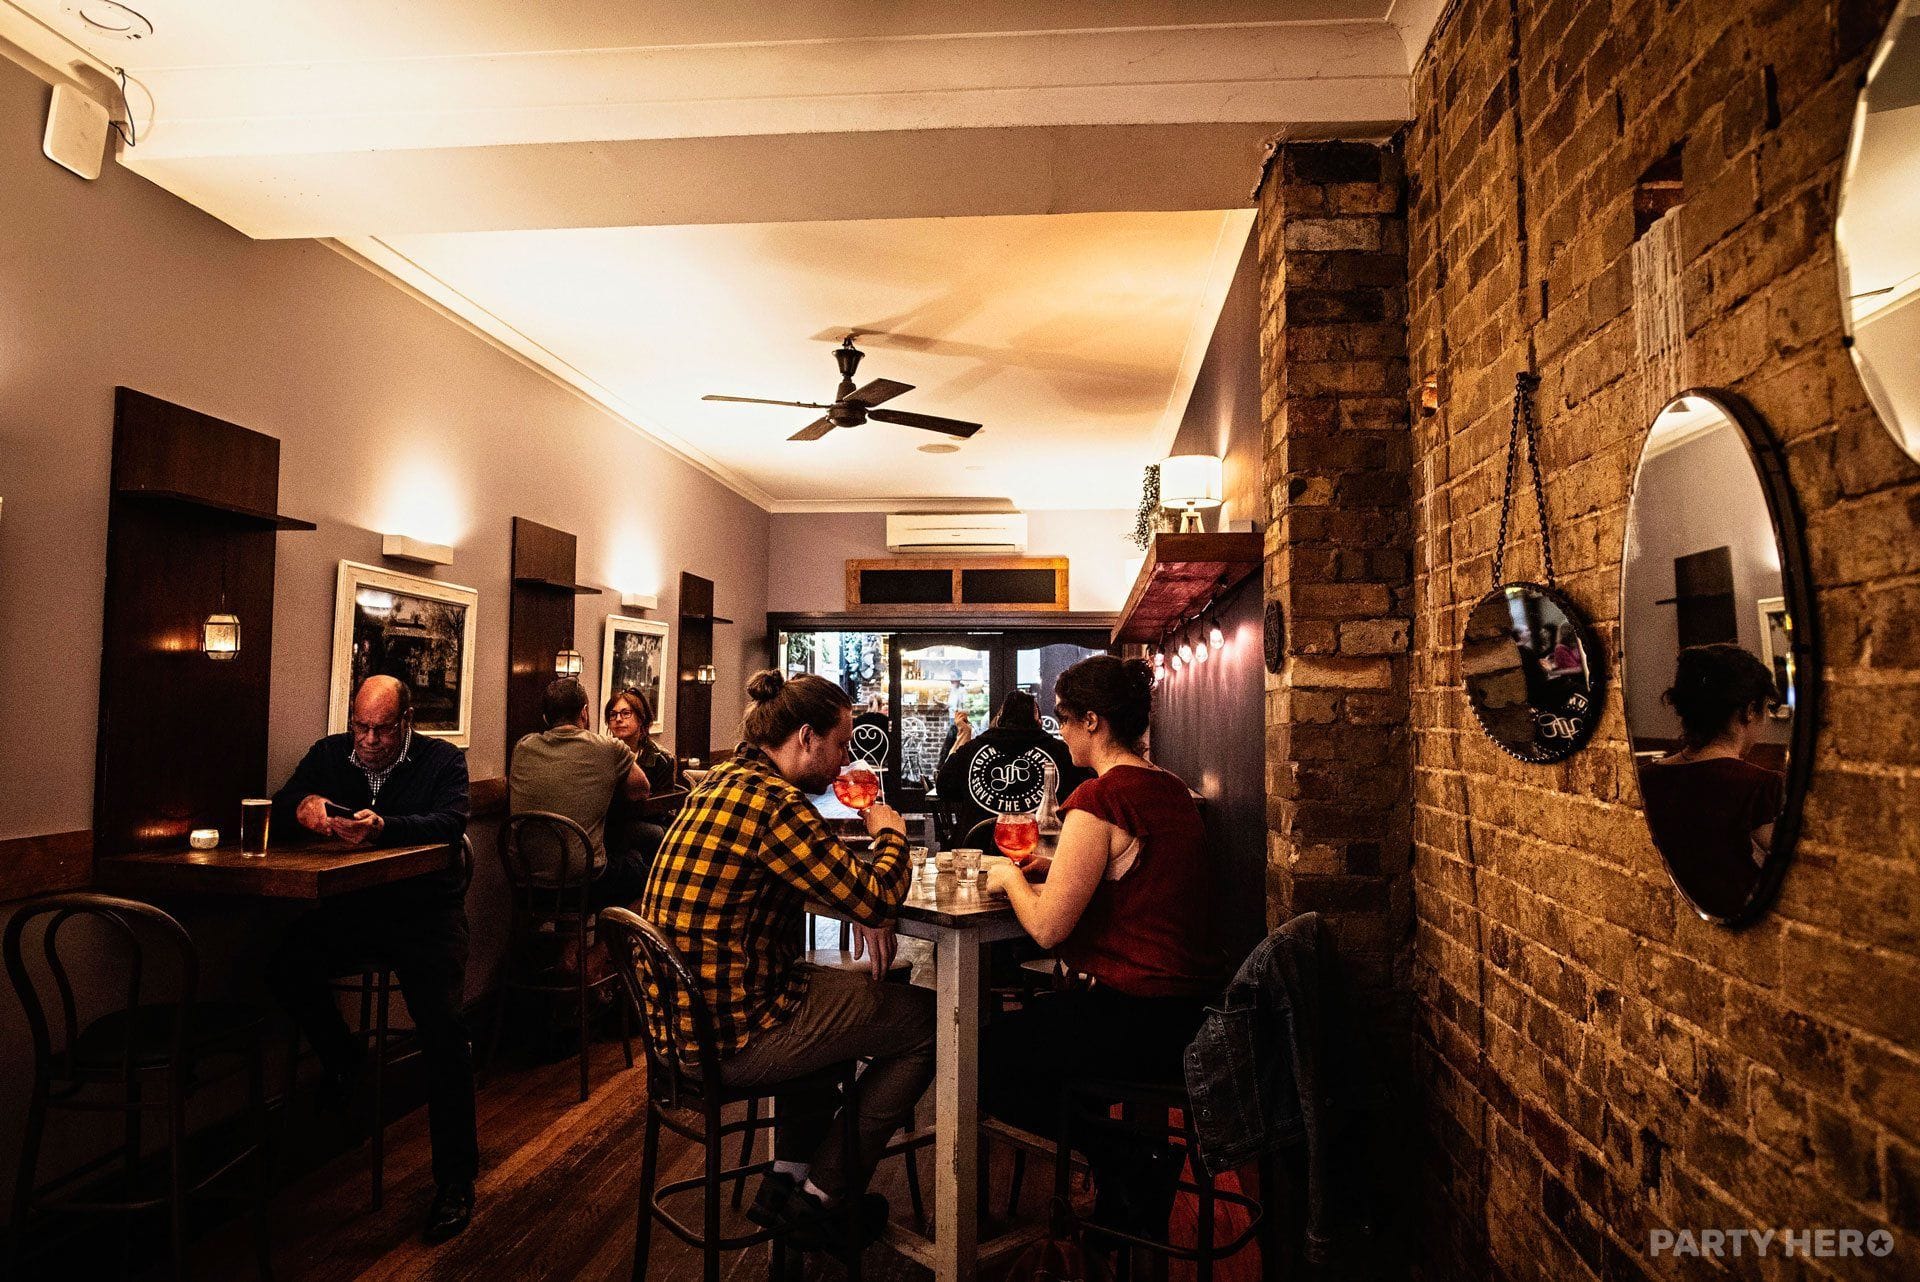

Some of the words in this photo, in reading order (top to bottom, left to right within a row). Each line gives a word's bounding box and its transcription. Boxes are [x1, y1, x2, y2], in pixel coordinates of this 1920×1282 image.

[972, 747, 997, 772] YOUN
[972, 776, 994, 806] SERVE
[997, 799, 1020, 812] THE
